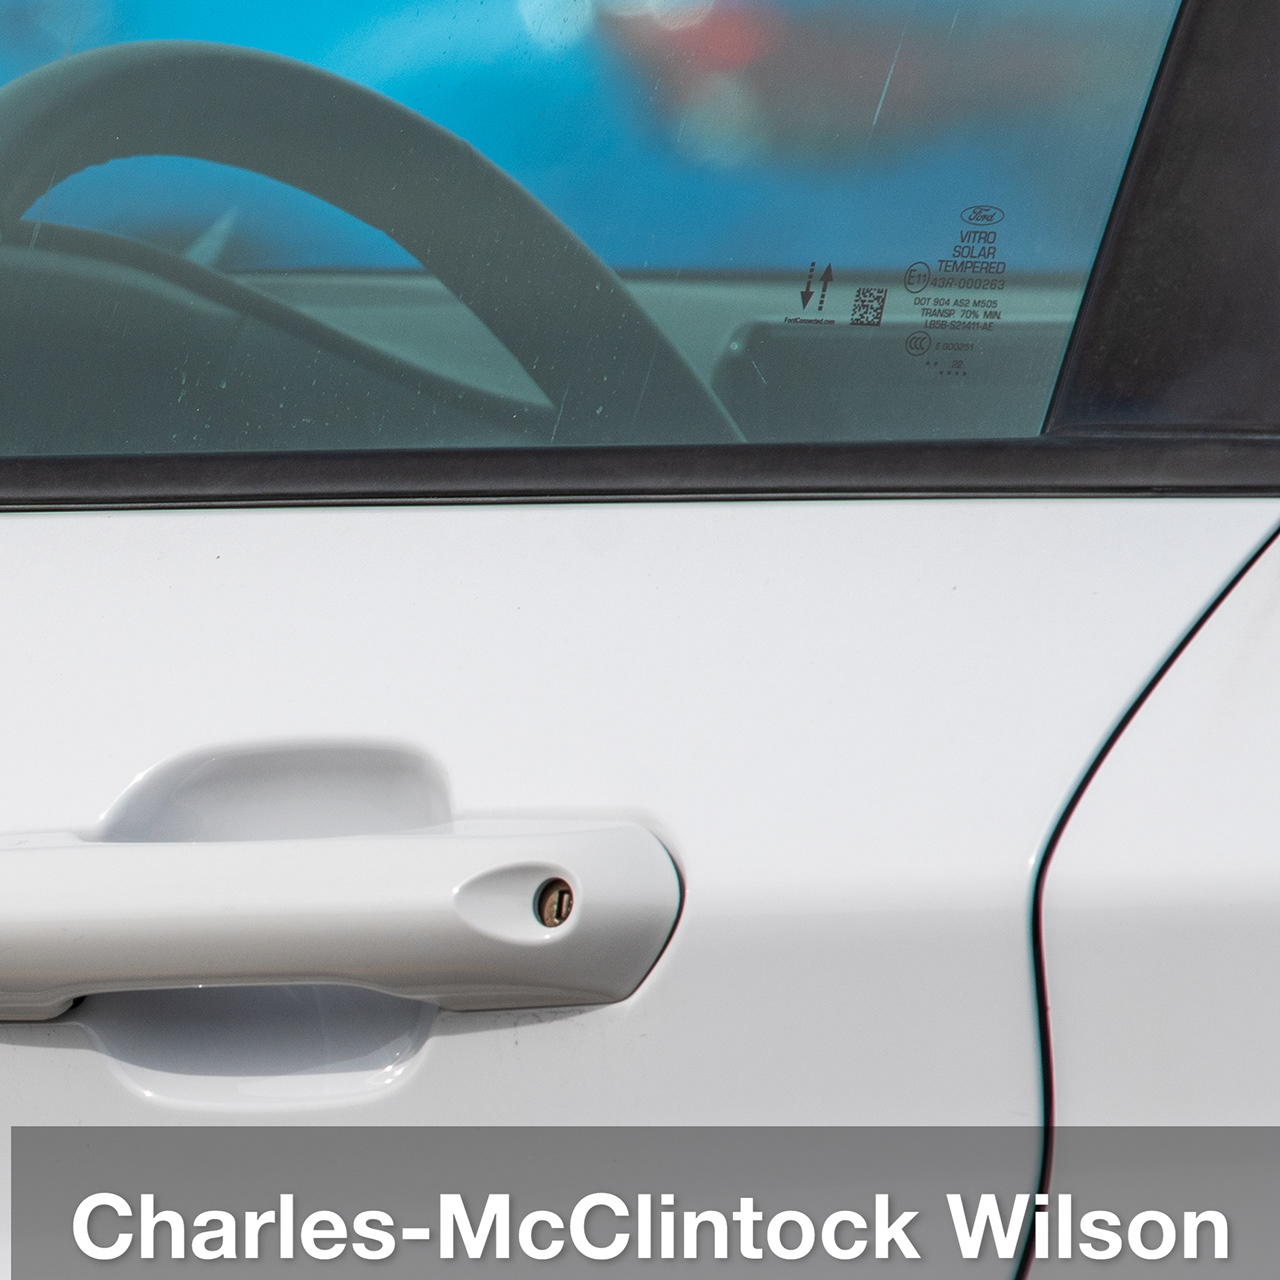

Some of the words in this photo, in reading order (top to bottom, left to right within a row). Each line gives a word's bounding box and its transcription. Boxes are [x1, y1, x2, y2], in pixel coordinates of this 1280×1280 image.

[968, 207, 997, 222] Ford
[960, 230, 997, 244] VITRO
[952, 245, 997, 259] SOLAR
[938, 259, 1006, 274] TEMPERED
[907, 269, 927, 286] E11
[930, 276, 1006, 290] 43R-000263
[913, 297, 931, 306] DOT
[933, 298, 950, 307] 904
[953, 299, 971, 308] AS2
[972, 300, 998, 309] M505
[960, 310, 980, 319] 70%
